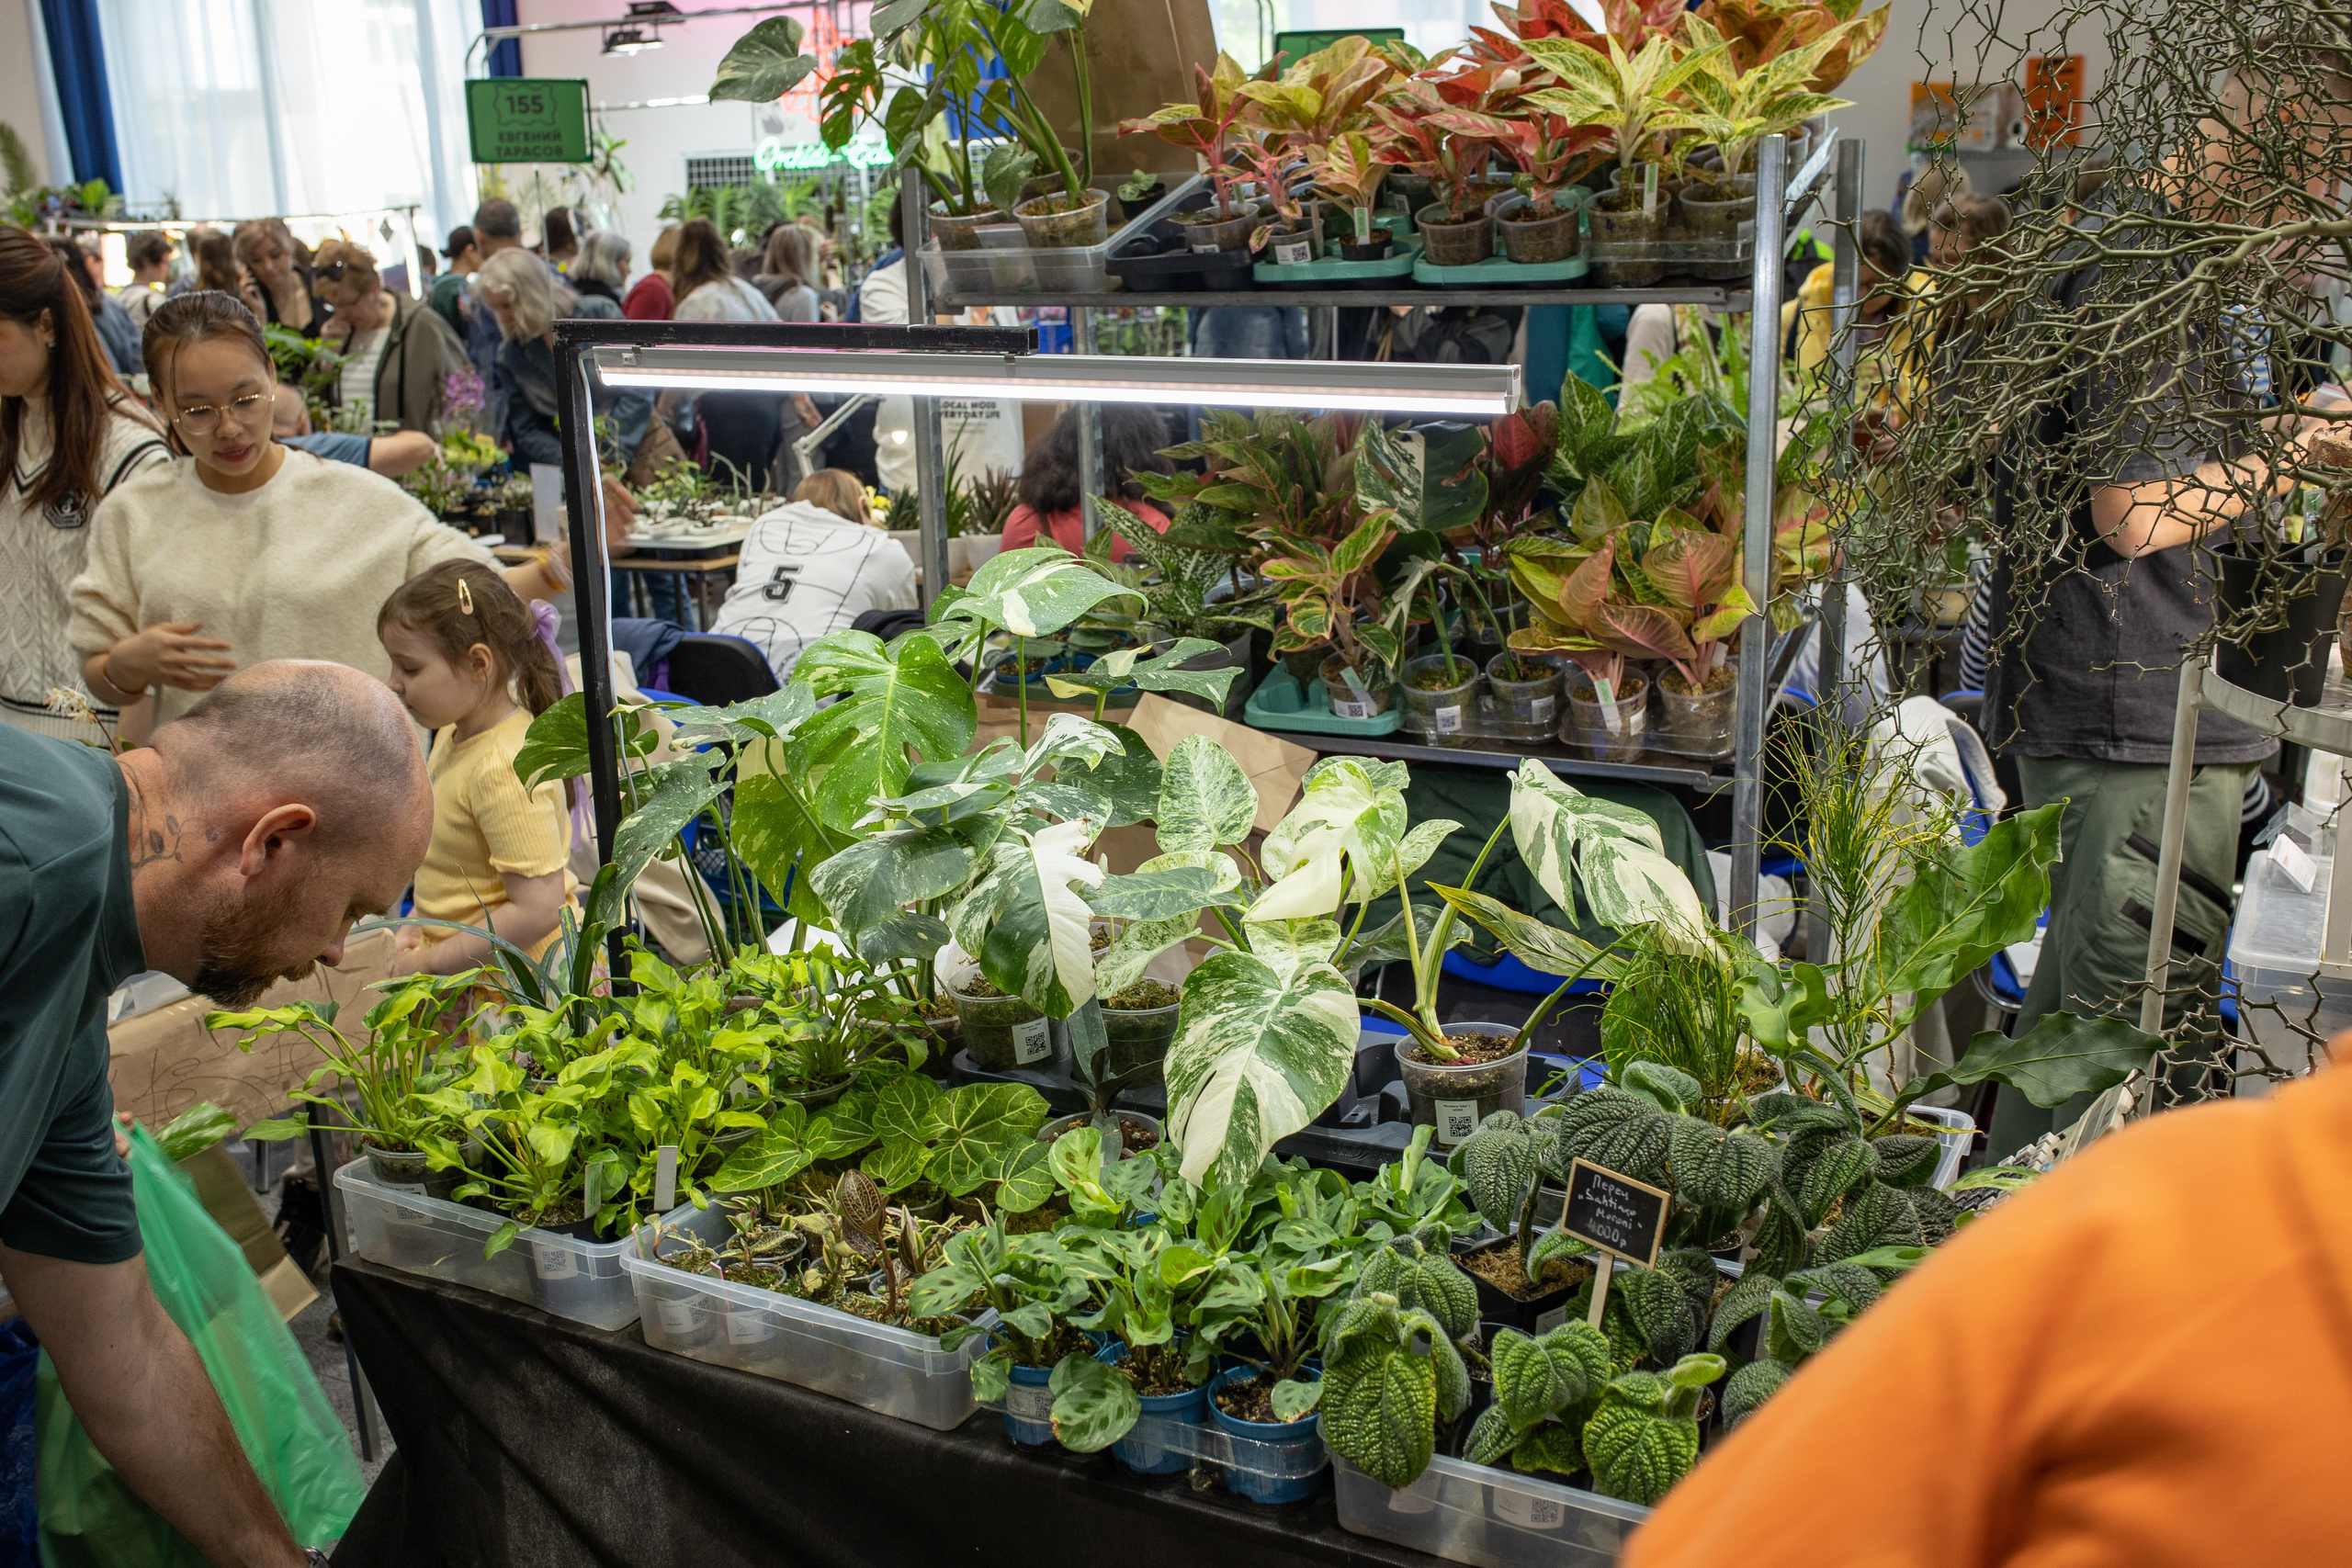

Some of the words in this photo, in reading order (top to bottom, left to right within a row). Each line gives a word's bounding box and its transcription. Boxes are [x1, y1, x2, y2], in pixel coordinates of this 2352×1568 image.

[506, 95, 544, 114] 155
[498, 128, 561, 142] ЕВГЕНИЙ
[496, 144, 563, 157] ТАРАСОВ
[762, 564, 804, 604] 5
[1592, 1174, 1629, 1201] Перец
